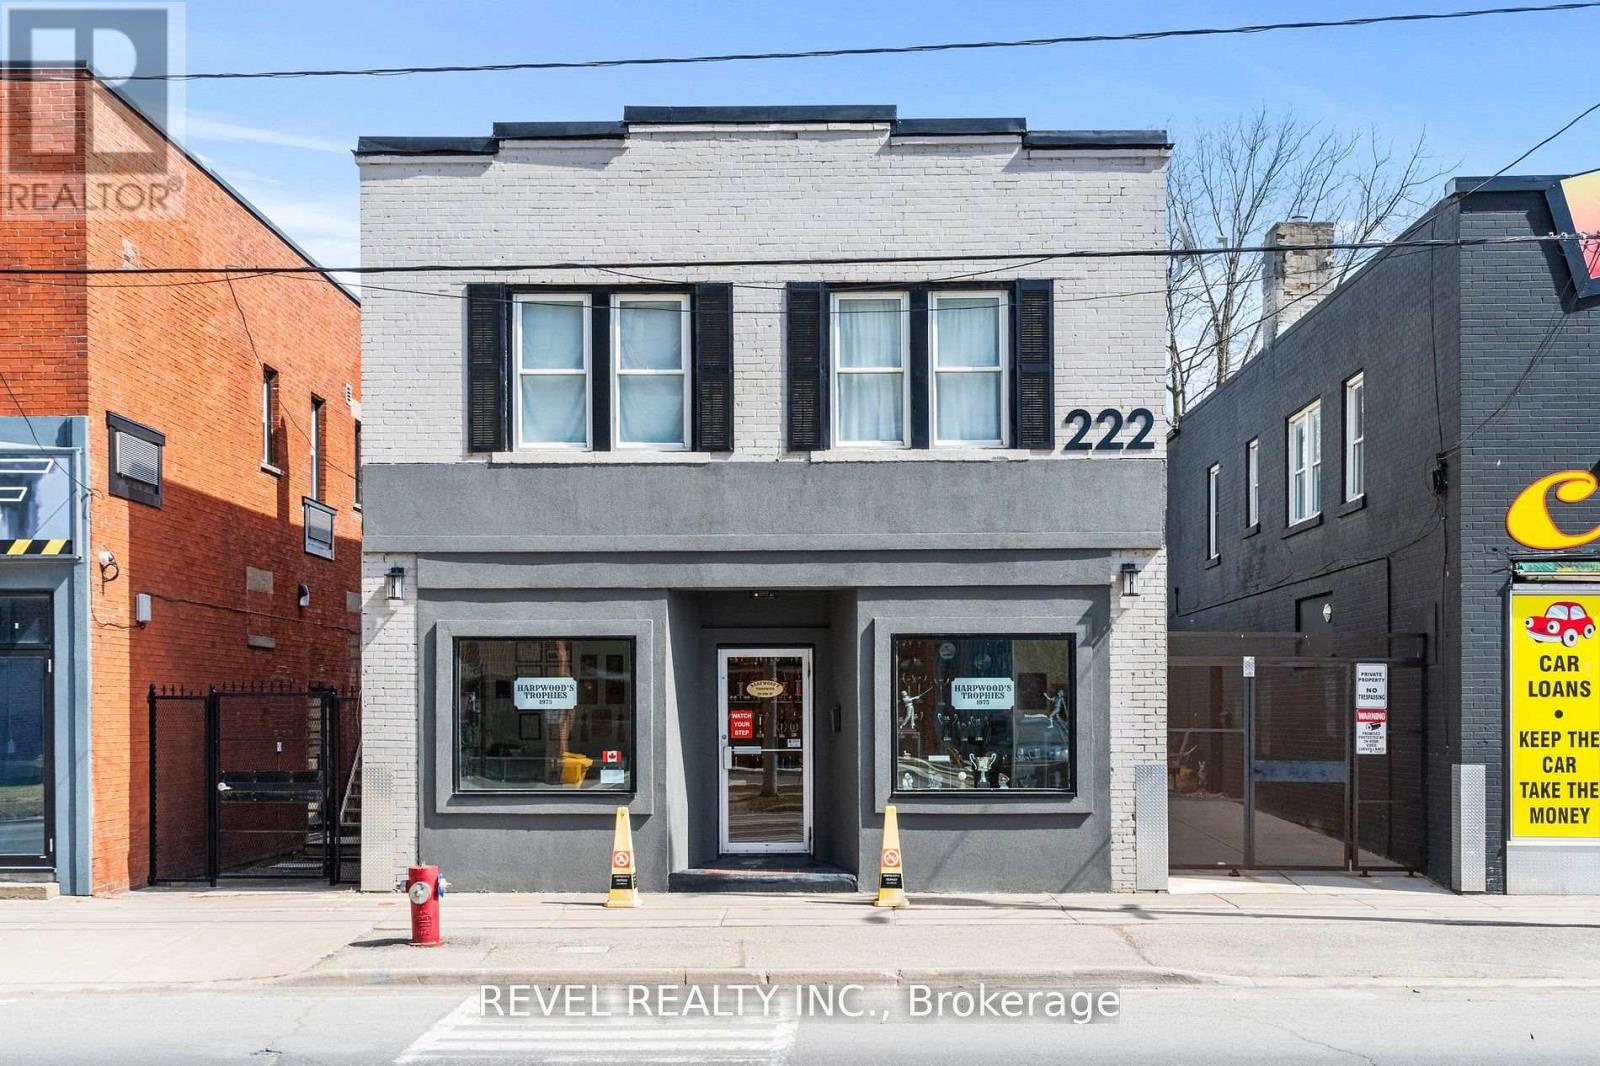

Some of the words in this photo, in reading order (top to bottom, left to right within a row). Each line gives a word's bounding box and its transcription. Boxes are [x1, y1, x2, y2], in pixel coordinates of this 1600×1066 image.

[1063, 408, 1154, 450] 222
[1539, 655, 1579, 672] CAR
[517, 684, 575, 692] HARPWOOD'S
[523, 691, 568, 699] TROPHIES
[954, 684, 1012, 692] HARPWOOD'S
[961, 691, 1005, 699] TROPHIES
[1528, 680, 1592, 698] LOANS
[1358, 712, 1386, 720] WARNING
[1519, 731, 1562, 748] KEEP
[1567, 731, 1600, 748] THE
[1542, 756, 1576, 773] CAR
[1519, 781, 1561, 798] TAKE
[1567, 781, 1599, 798] THE
[1529, 807, 1590, 824] MONEY
